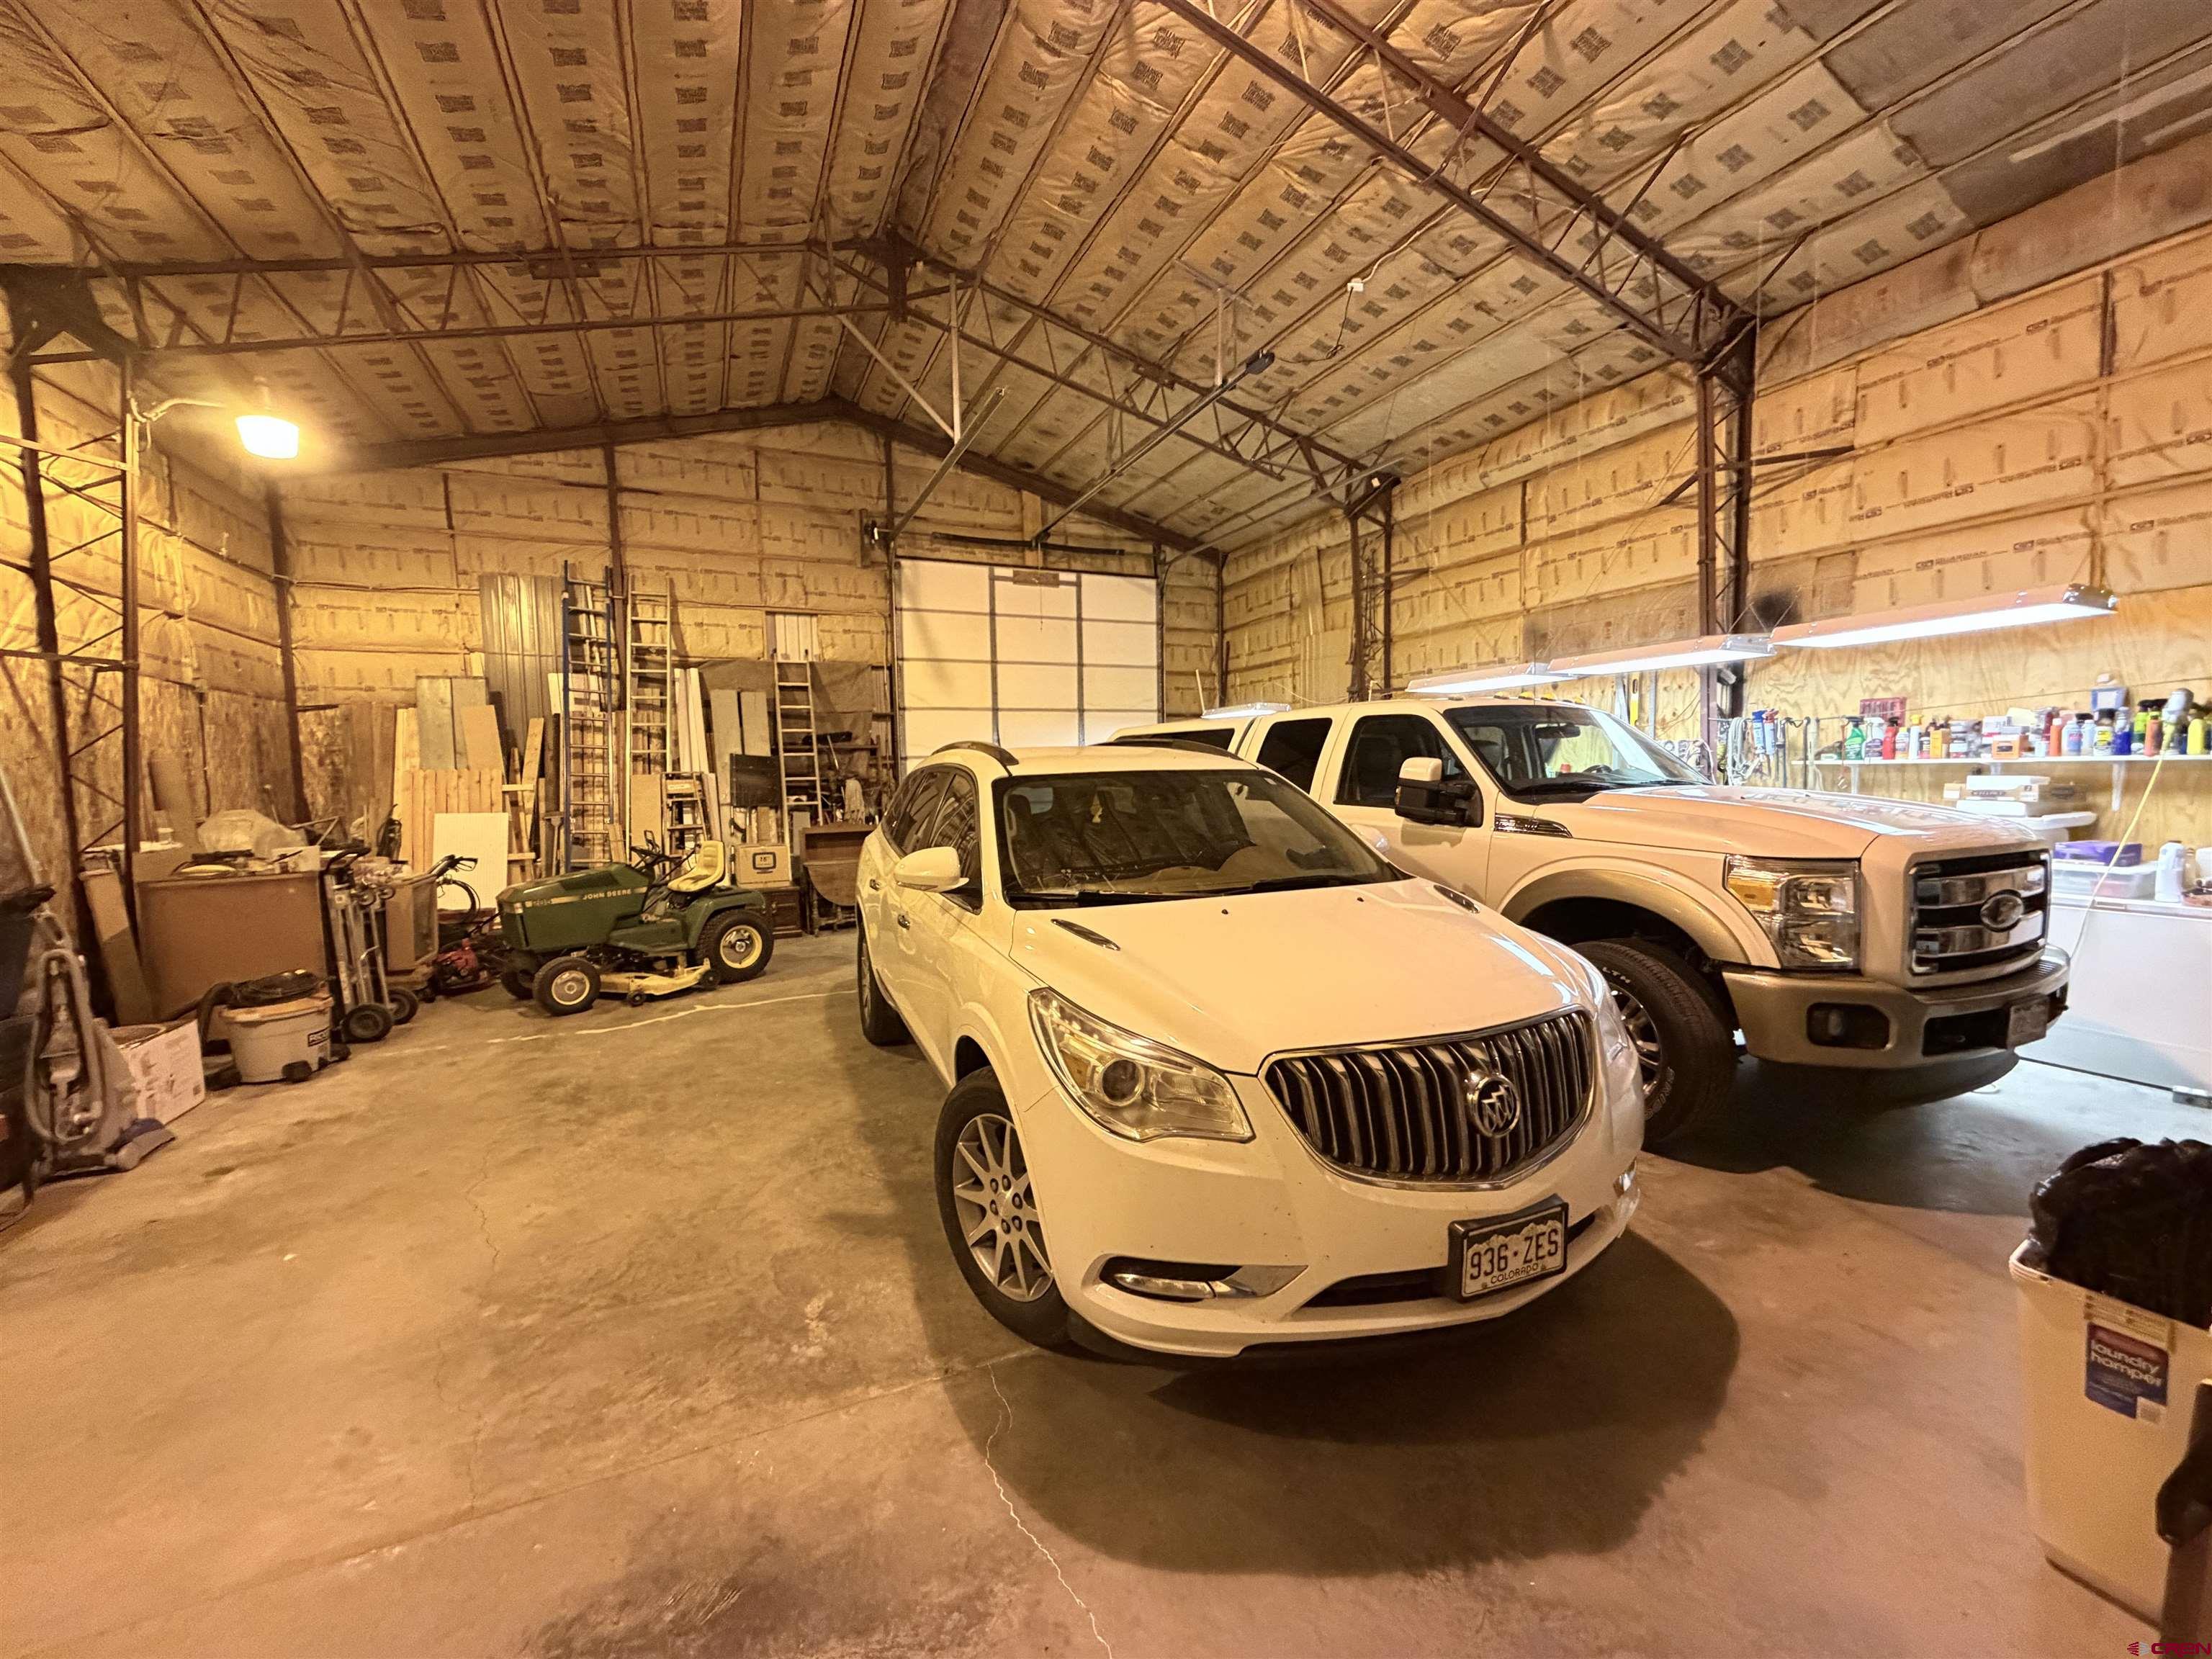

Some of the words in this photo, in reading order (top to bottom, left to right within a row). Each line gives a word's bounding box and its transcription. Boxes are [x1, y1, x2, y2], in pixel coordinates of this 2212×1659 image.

[583, 892, 605, 901] JOHN
[606, 889, 631, 898] DEERE
[1490, 1262, 1539, 1285] COLORADO
[2090, 1340, 2159, 1374] laundry
[2090, 1351, 2162, 1387] hamper
